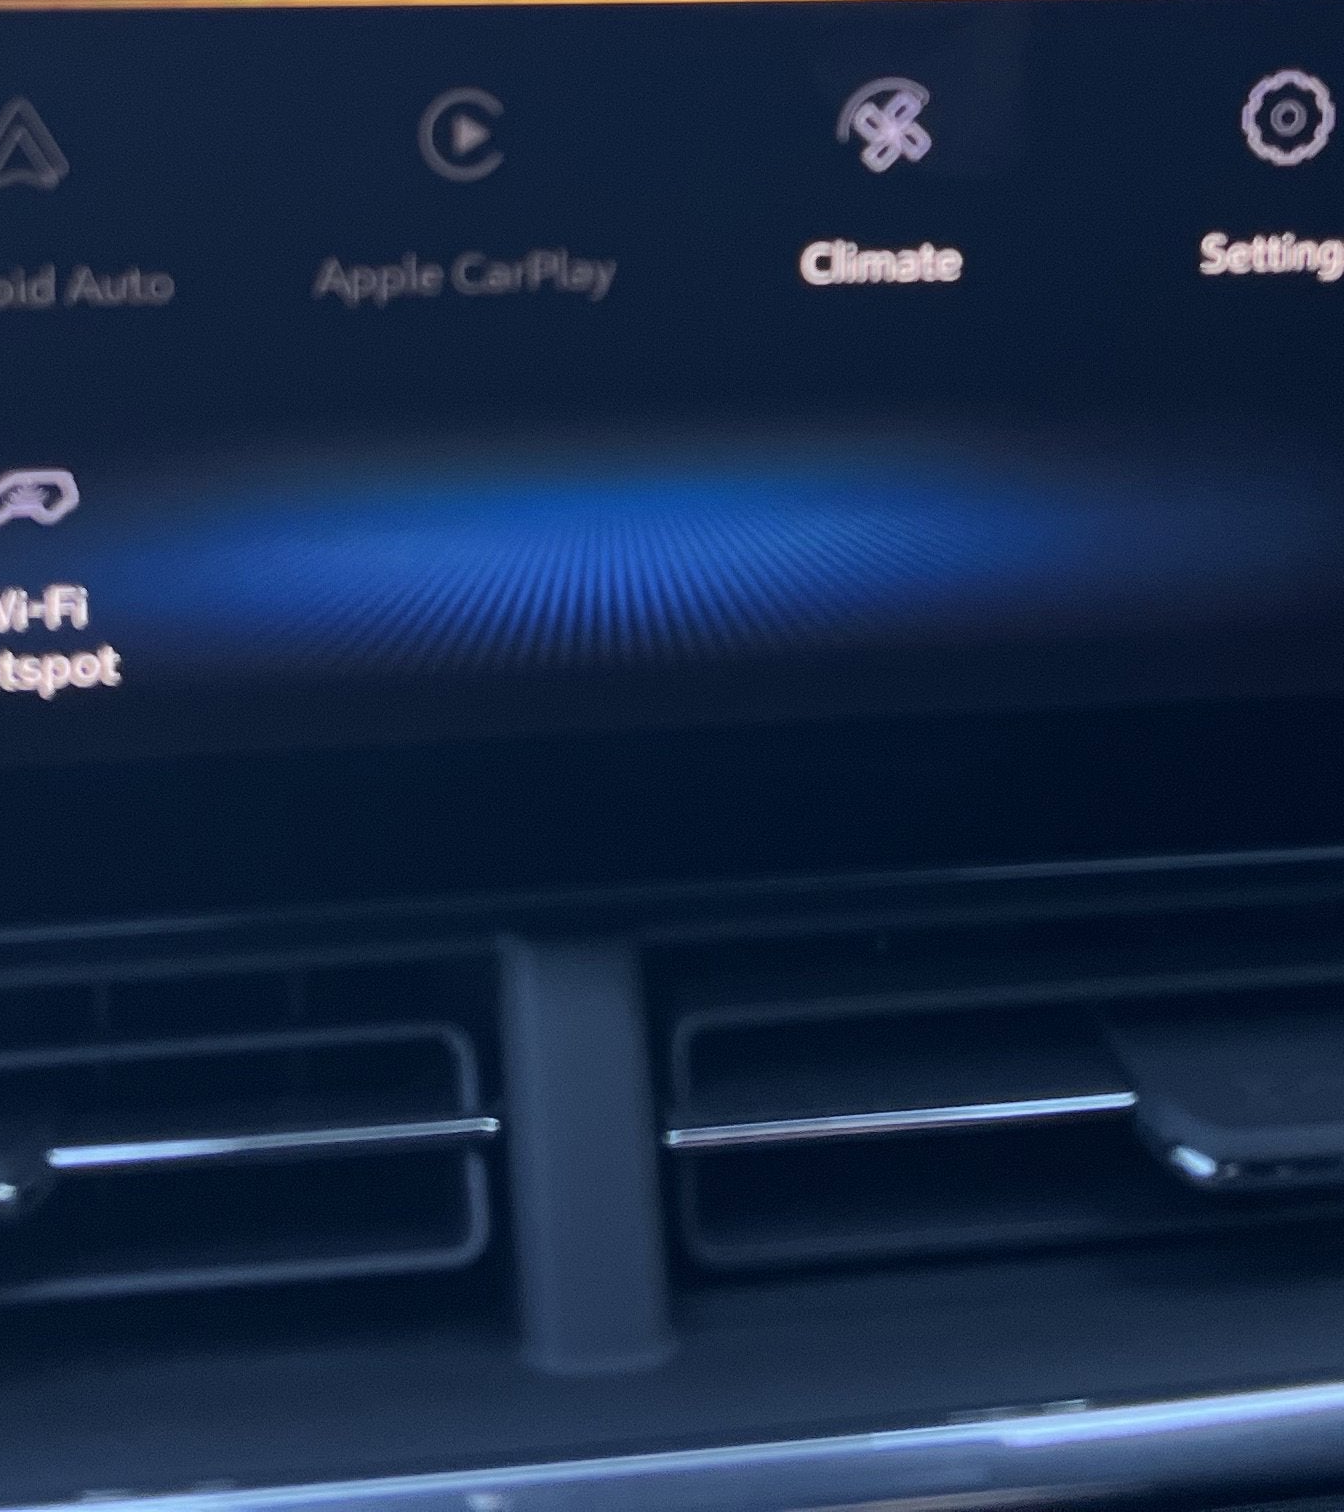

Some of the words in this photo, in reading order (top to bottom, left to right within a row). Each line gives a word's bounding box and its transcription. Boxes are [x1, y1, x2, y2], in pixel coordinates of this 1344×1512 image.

[64, 264, 176, 307] Auto
[312, 253, 444, 307] Apple
[451, 248, 617, 302] CarPlay
[799, 238, 965, 287] Climate
